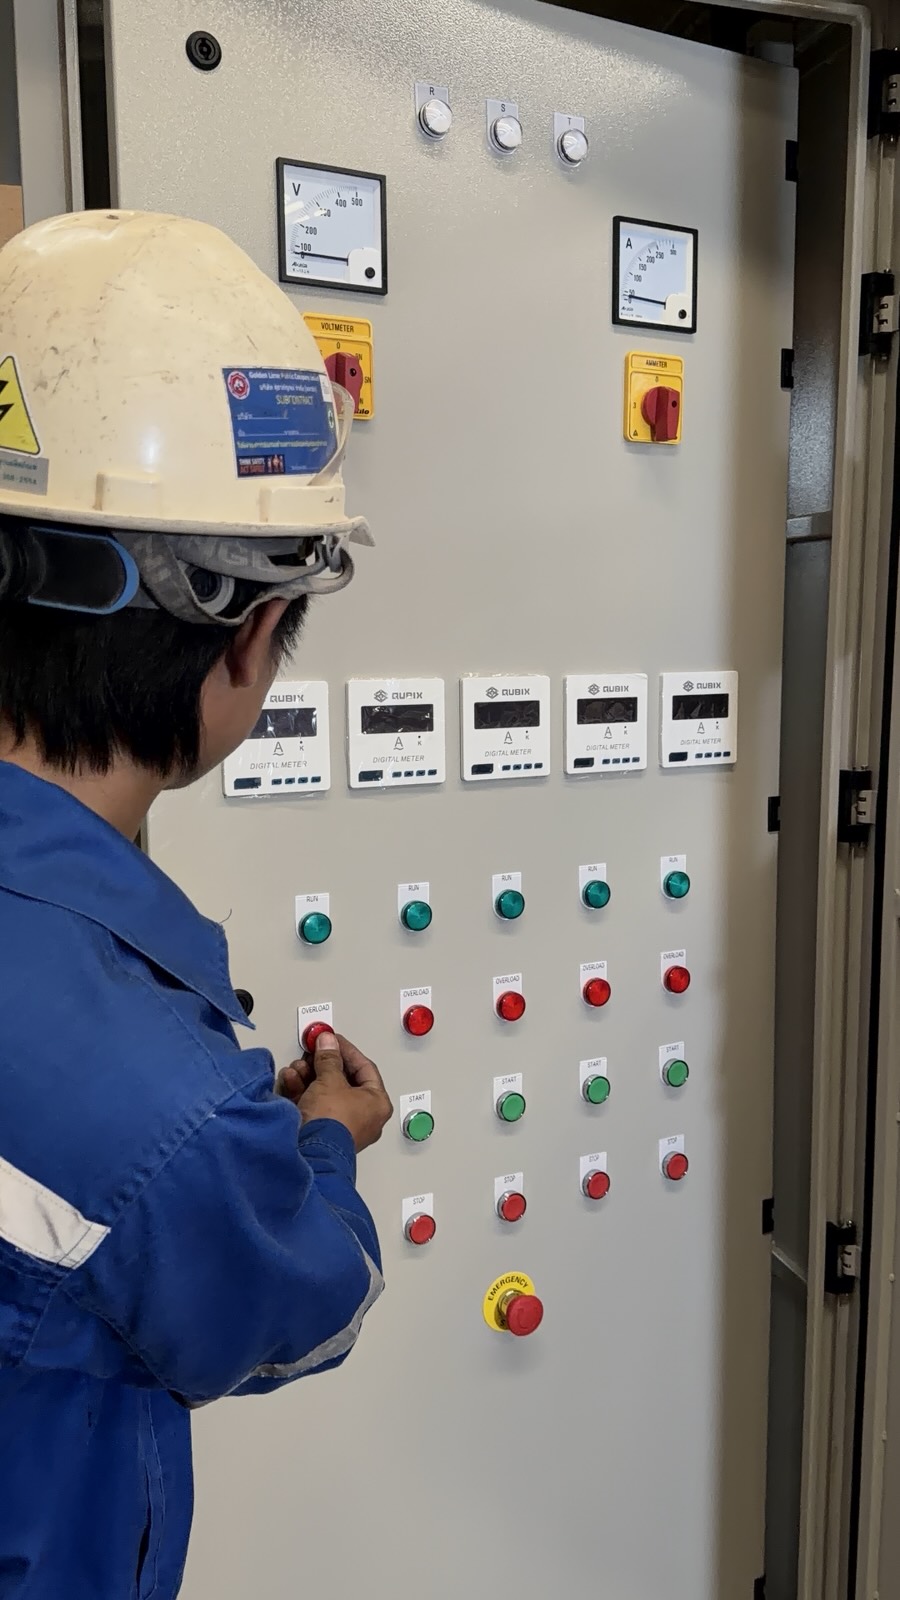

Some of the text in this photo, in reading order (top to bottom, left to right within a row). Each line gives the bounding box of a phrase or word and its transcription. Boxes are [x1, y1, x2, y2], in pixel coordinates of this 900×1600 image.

[430, 87, 434, 96] R
[501, 104, 506, 112] S
[567, 117, 572, 125] T
[292, 182, 301, 196] V
[335, 198, 347, 208] 400
[352, 198, 363, 206] 500
[305, 226, 318, 236] 200
[300, 242, 312, 252] 100
[626, 238, 632, 250] A
[646, 256, 655, 264] 200
[656, 251, 664, 260] 250
[639, 263, 647, 272] 150
[634, 274, 642, 282] 100
[321, 322, 354, 333] VOLTMETER
[646, 360, 667, 368] AMMETER
[604, 726, 612, 736] A
[698, 722, 705, 732] A
[504, 731, 512, 741] A
[274, 741, 283, 752] A
[394, 736, 403, 748] A
[582, 963, 605, 971] OVERLOAD
[496, 975, 520, 984] OVERLOAD
[403, 988, 429, 997] OVERLOAD
[301, 1004, 330, 1014] OVERLOAD
[502, 1076, 517, 1084] START
[409, 1094, 425, 1102] START
[667, 1137, 677, 1145] STOP
[504, 1175, 516, 1183] STOP
[413, 1196, 425, 1205] STOP
[488, 1276, 528, 1301] EMERGENCY
